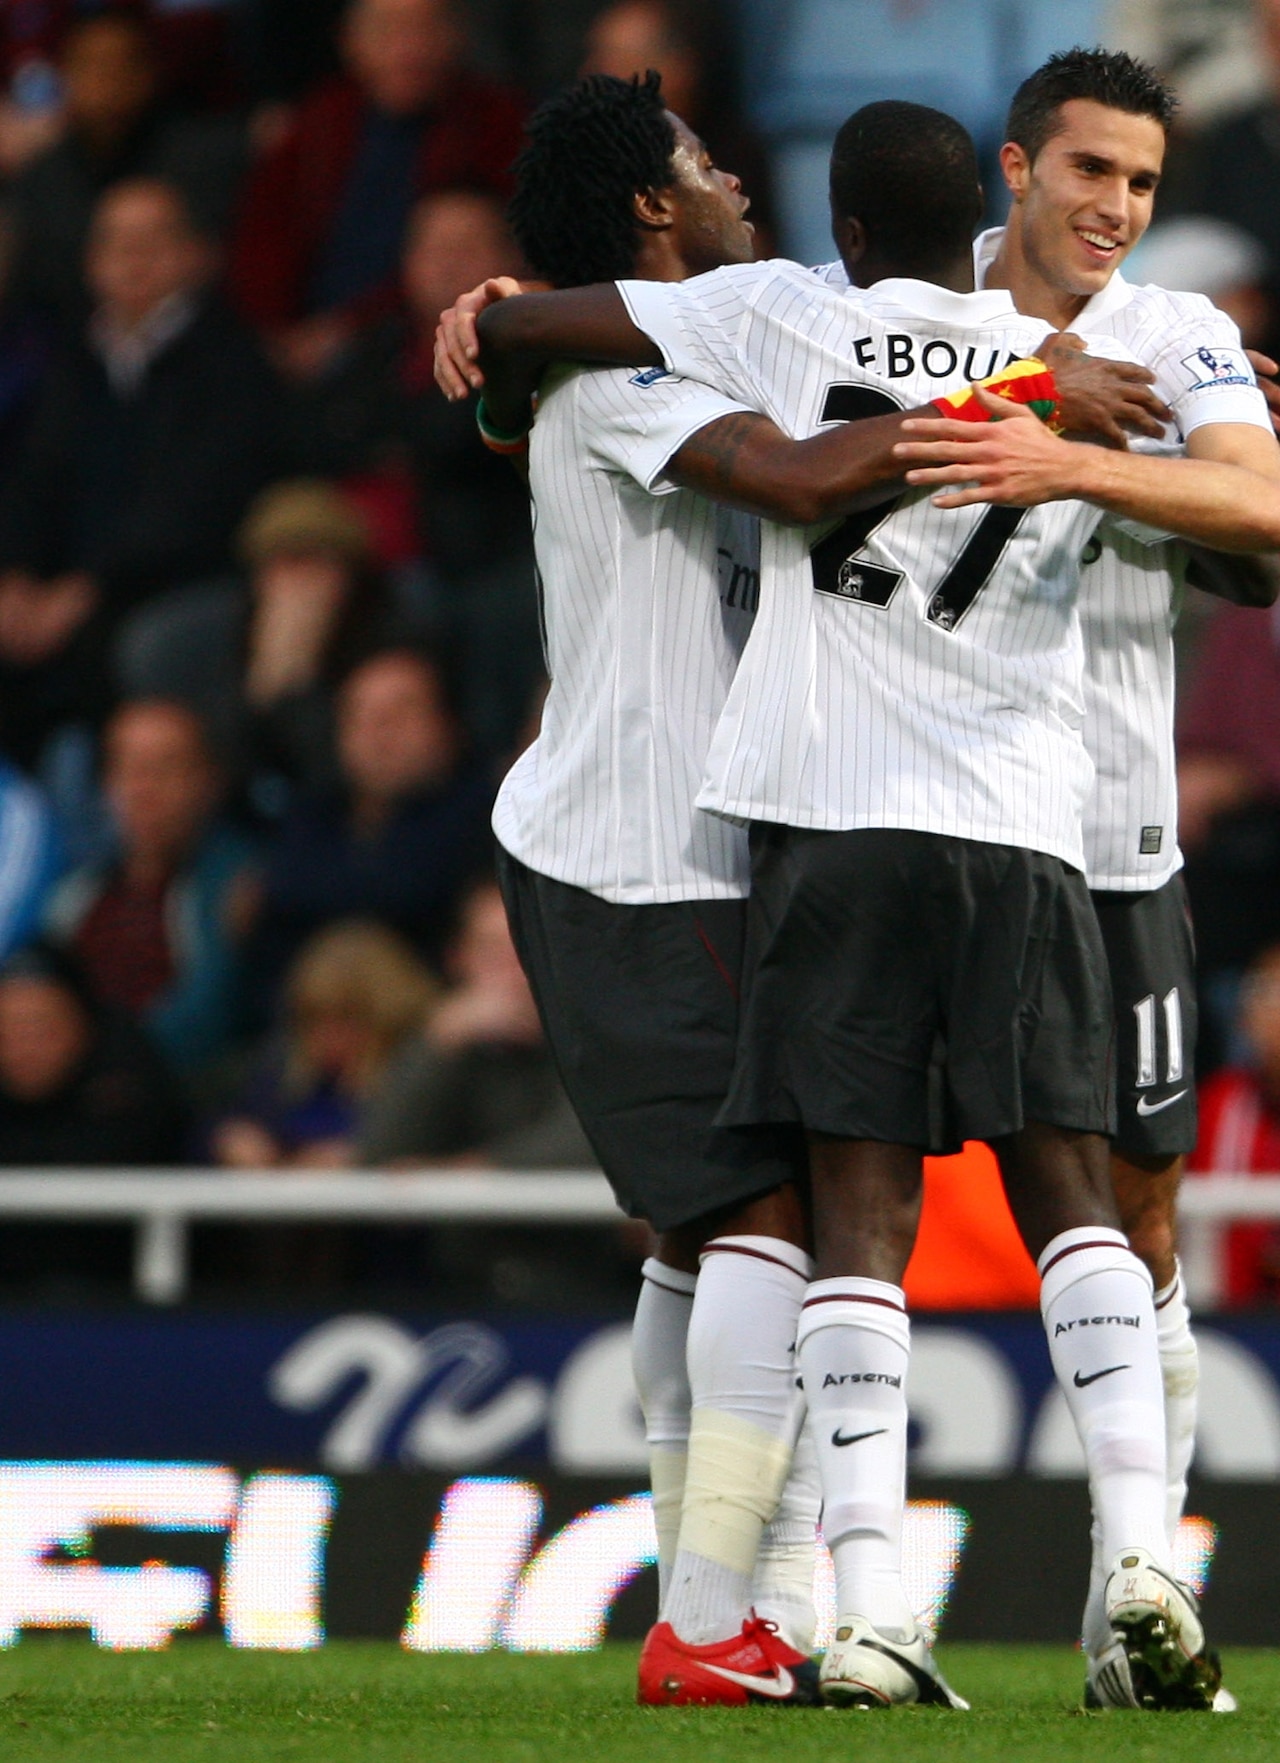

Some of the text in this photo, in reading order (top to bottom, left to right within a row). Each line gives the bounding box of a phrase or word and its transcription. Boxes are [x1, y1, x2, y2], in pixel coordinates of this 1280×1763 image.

[852, 334, 1022, 383] EBOU
[1134, 987, 1183, 1087] 11
[1054, 1315, 1141, 1339] Arsenal
[822, 1372, 902, 1390] Arsenal
